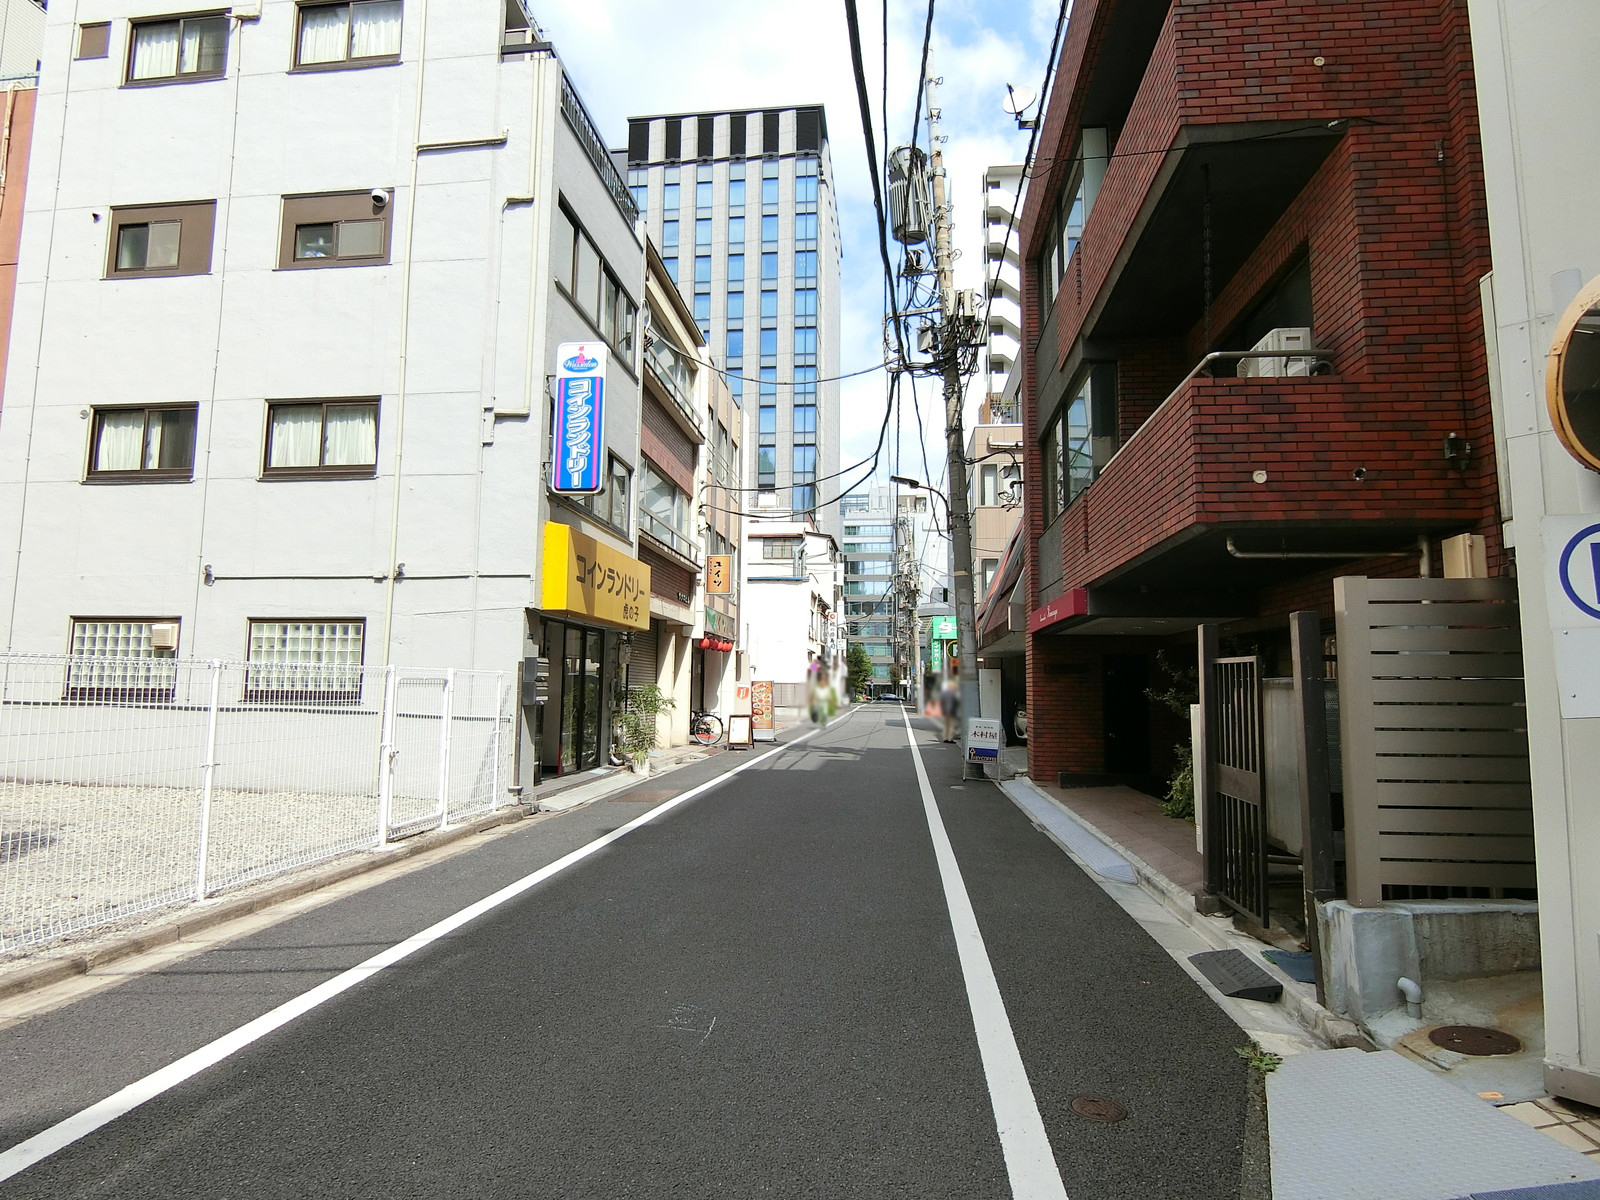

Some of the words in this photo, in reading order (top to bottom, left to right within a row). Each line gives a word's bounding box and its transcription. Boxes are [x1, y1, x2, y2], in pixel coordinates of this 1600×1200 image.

[567, 379, 592, 488] コインランドリー
[576, 554, 645, 602] コインランドリー
[623, 603, 639, 622] 虎の子
